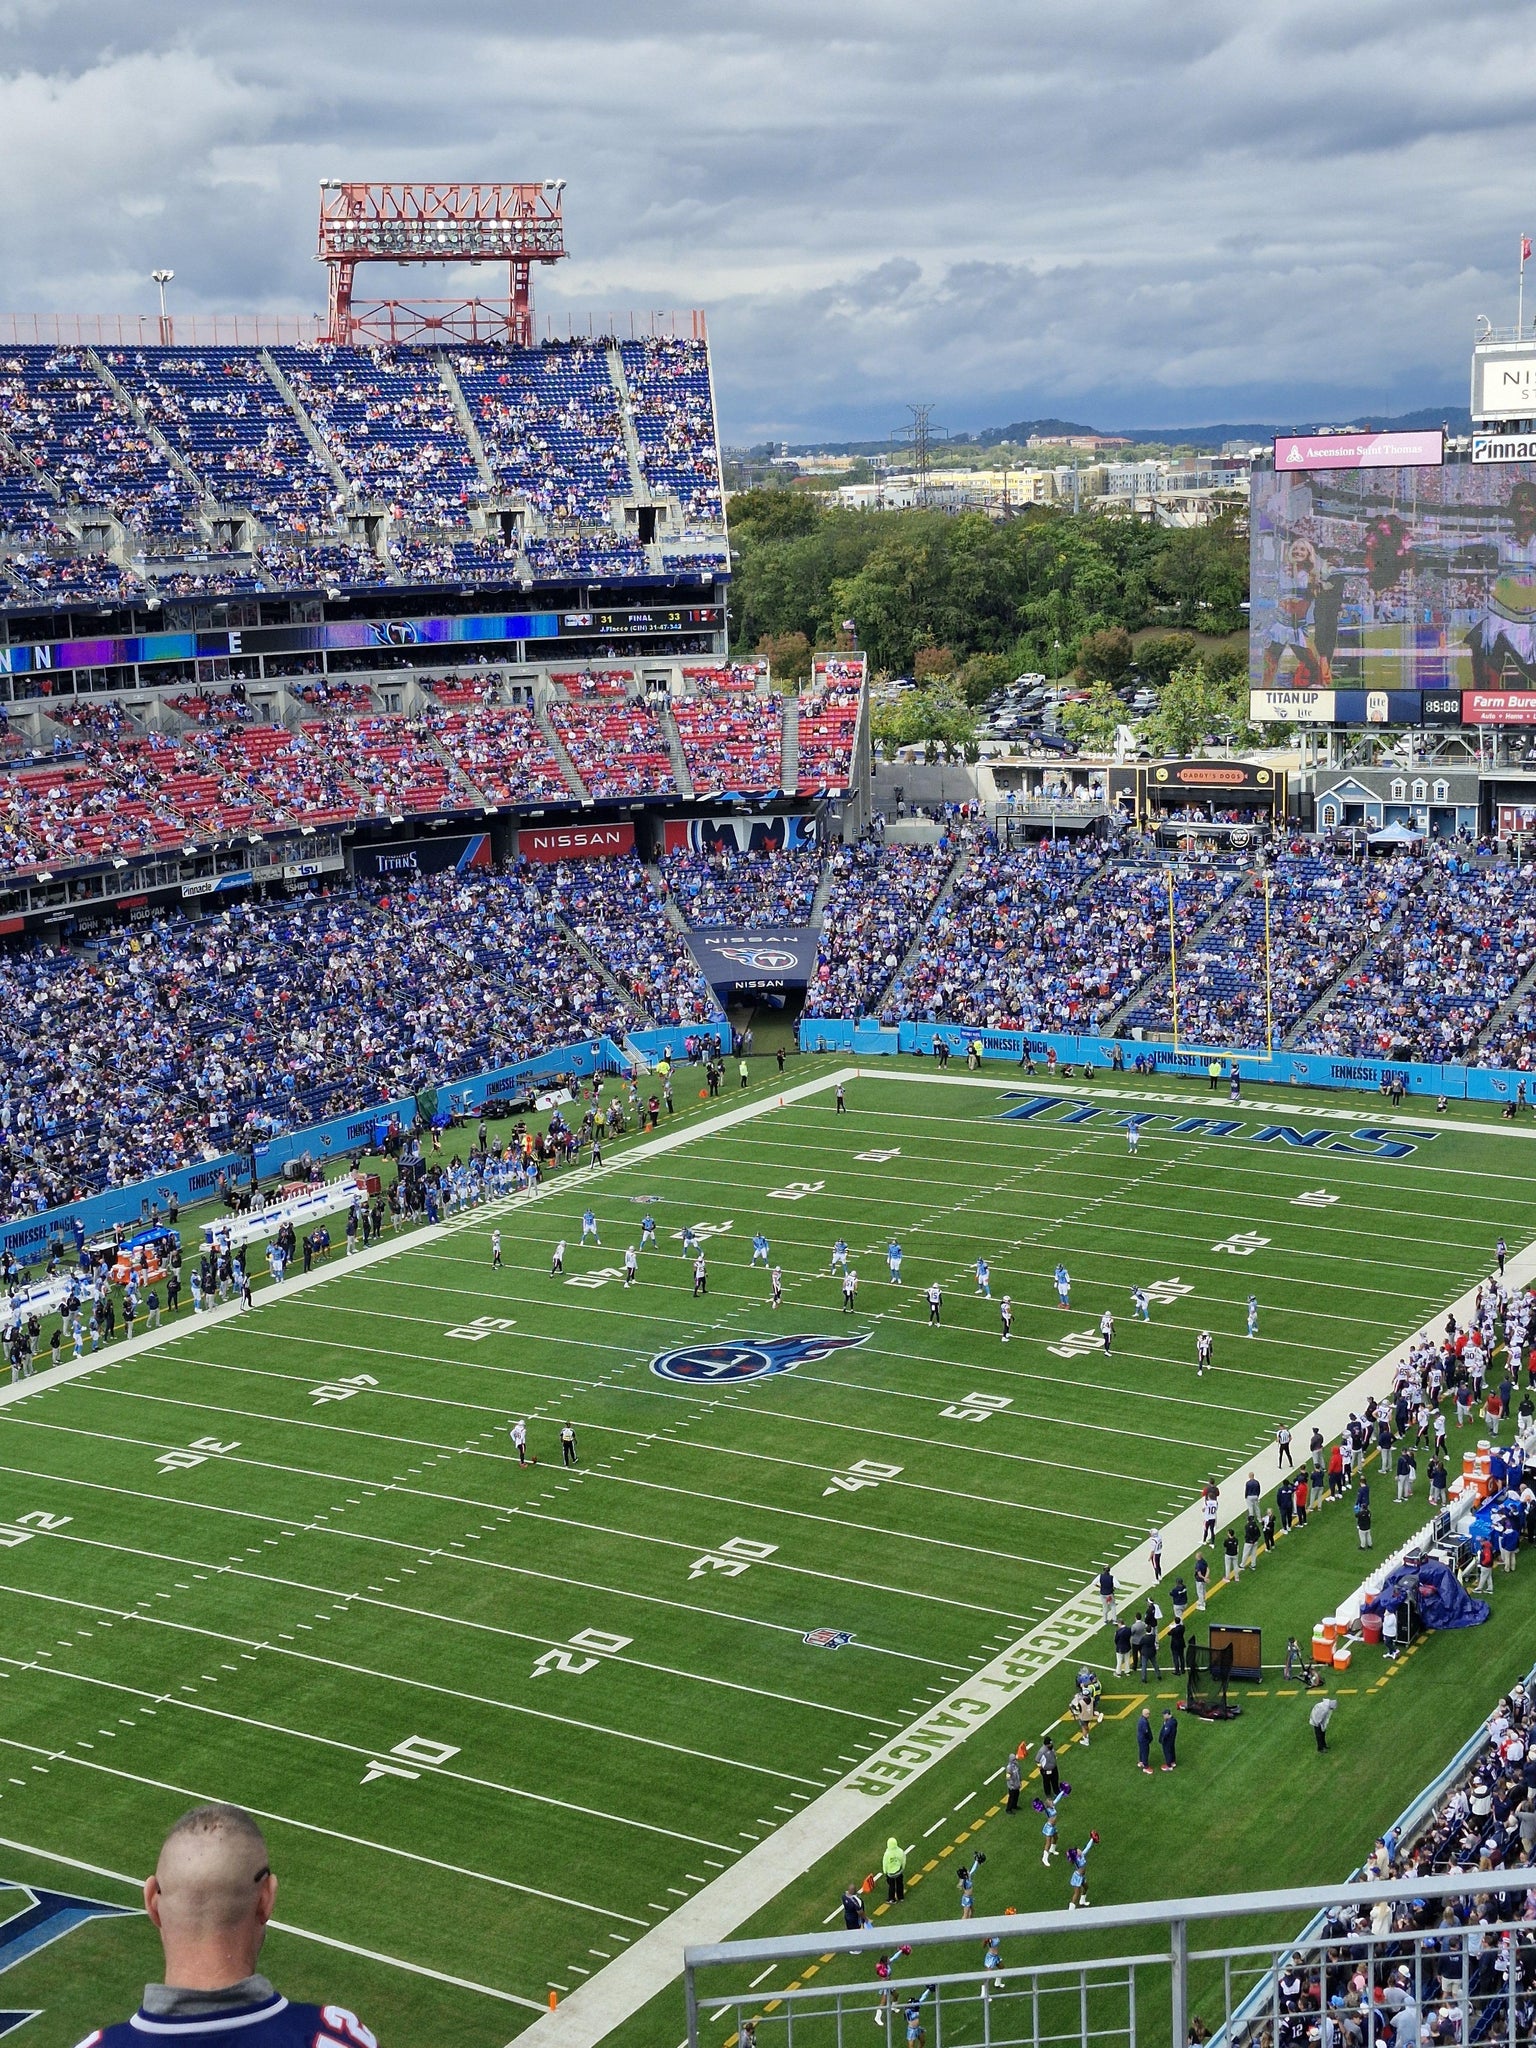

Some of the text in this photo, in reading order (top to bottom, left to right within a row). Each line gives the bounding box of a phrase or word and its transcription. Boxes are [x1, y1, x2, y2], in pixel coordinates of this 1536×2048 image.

[1503, 371, 1536, 386] NI
[1306, 445, 1423, 458] Ascension Saint Thomas
[600, 615, 612, 624] 31
[628, 614, 653, 622] FINAL
[35, 646, 51, 669] N
[228, 631, 243, 654] E
[1266, 693, 1319, 704] TITAN UP
[1473, 695, 1505, 707] Farm
[534, 832, 620, 849] NISSAN
[375, 850, 417, 873] TITANS
[705, 936, 798, 945] NISSAN
[735, 980, 784, 989] NISSAN
[981, 1036, 1020, 1052] TENNESSEE
[1154, 1050, 1197, 1067] TENNESSEE
[1330, 1064, 1378, 1083] TENNESSEE
[486, 1075, 515, 1098] TENNESSEE
[1112, 1091, 1211, 1104] TAKES
[1223, 1100, 1280, 1112] ALL
[1297, 1106, 1340, 1118] OF
[1352, 1113, 1399, 1123] US
[980, 1091, 1441, 1159] TITANS
[766, 1181, 825, 1201] 20
[1290, 1193, 1341, 1208] 10
[3, 1223, 48, 1250] TENNESSEE
[1210, 1233, 1272, 1256] 20
[564, 1267, 625, 1290] 40
[444, 1315, 517, 1342] 50
[1047, 1332, 1106, 1359] 40
[307, 1374, 380, 1402] 40
[939, 1391, 1014, 1423] 50
[154, 1437, 242, 1469] 30
[830, 1459, 905, 1493] 40
[1207, 1505, 1217, 1515] 10
[694, 1536, 780, 1579] 30
[534, 1627, 634, 1676] 20
[845, 1581, 1143, 1797] INTERCEPT CANCER
[365, 1734, 462, 1780] 10
[1291, 2023, 1303, 2038] 12
